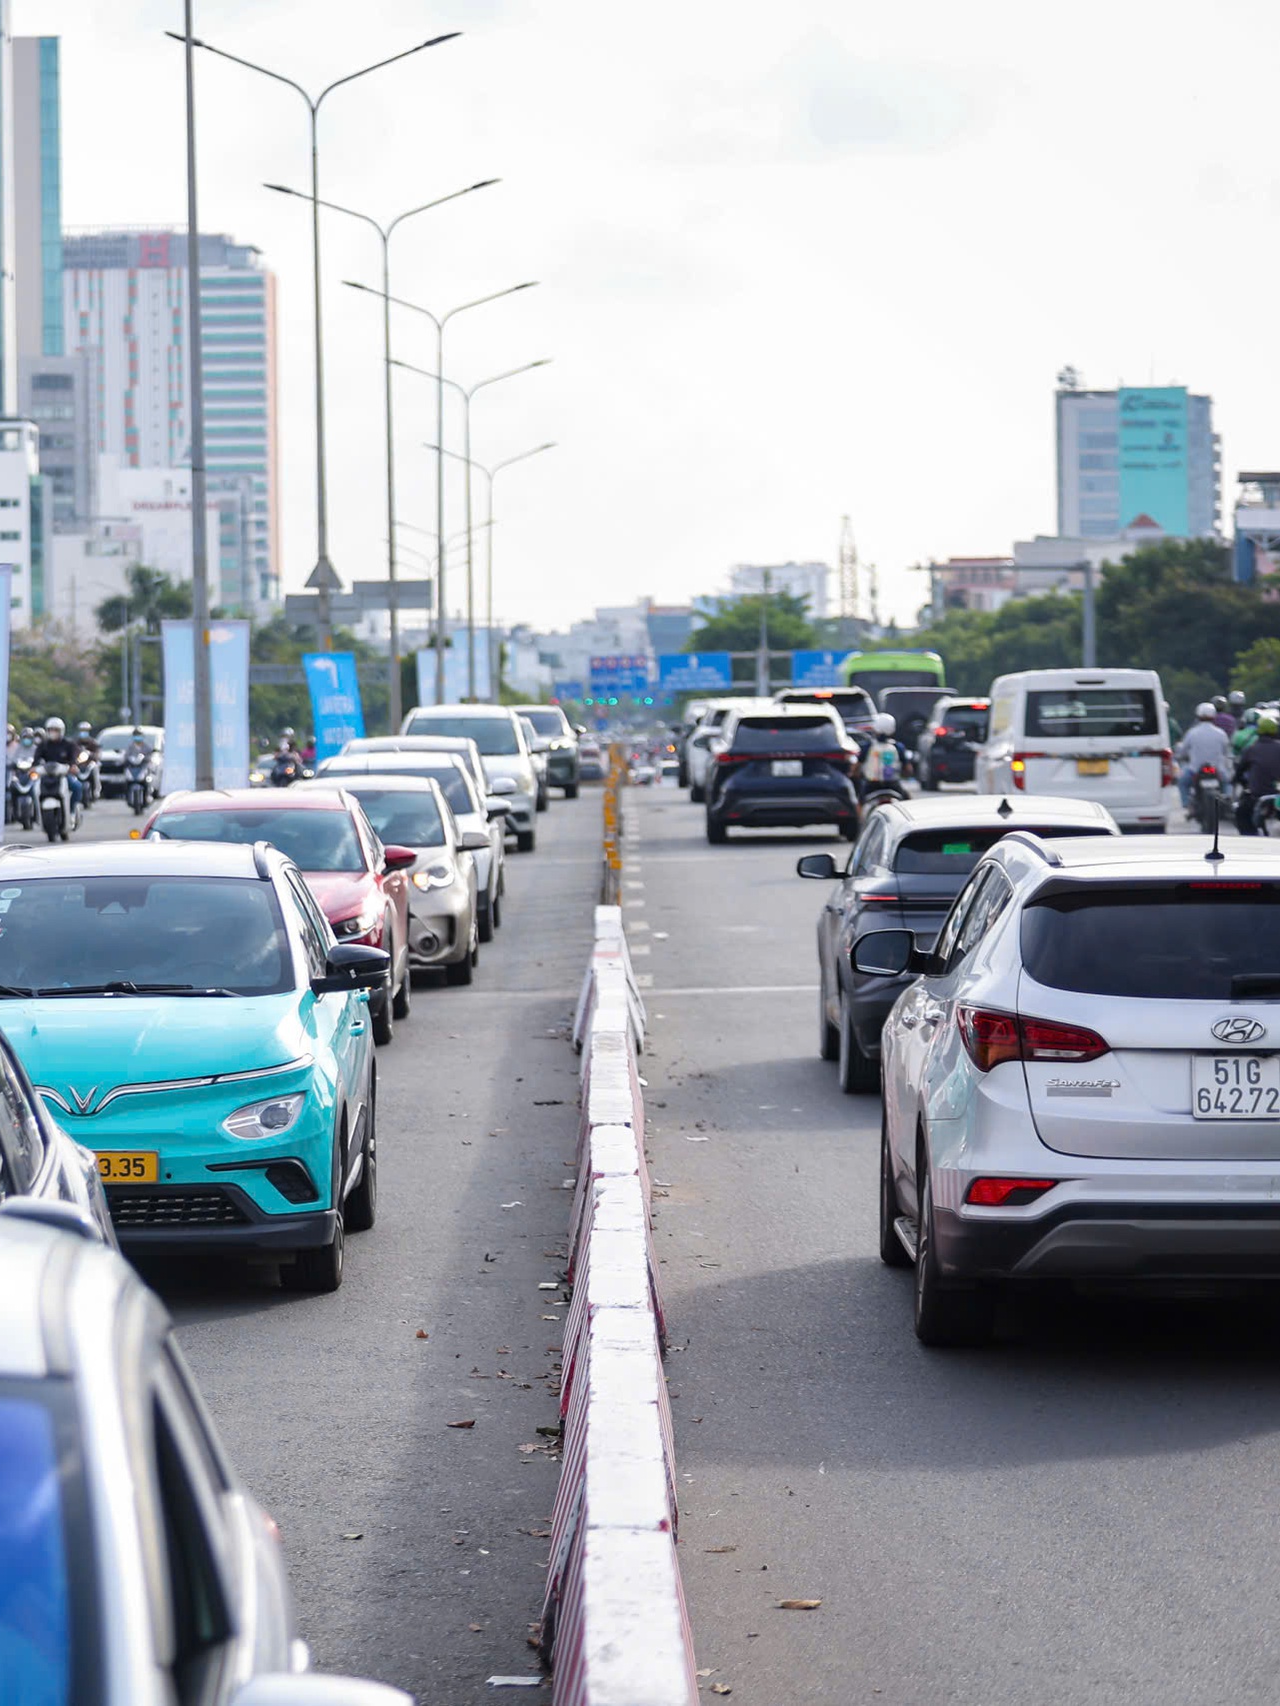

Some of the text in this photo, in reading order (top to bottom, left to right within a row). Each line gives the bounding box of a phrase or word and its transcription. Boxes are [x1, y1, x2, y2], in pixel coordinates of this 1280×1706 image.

[1214, 1059, 1261, 1085] 51G
[1197, 1087, 1280, 1113] 642.72
[99, 1157, 145, 1177] 3.35
